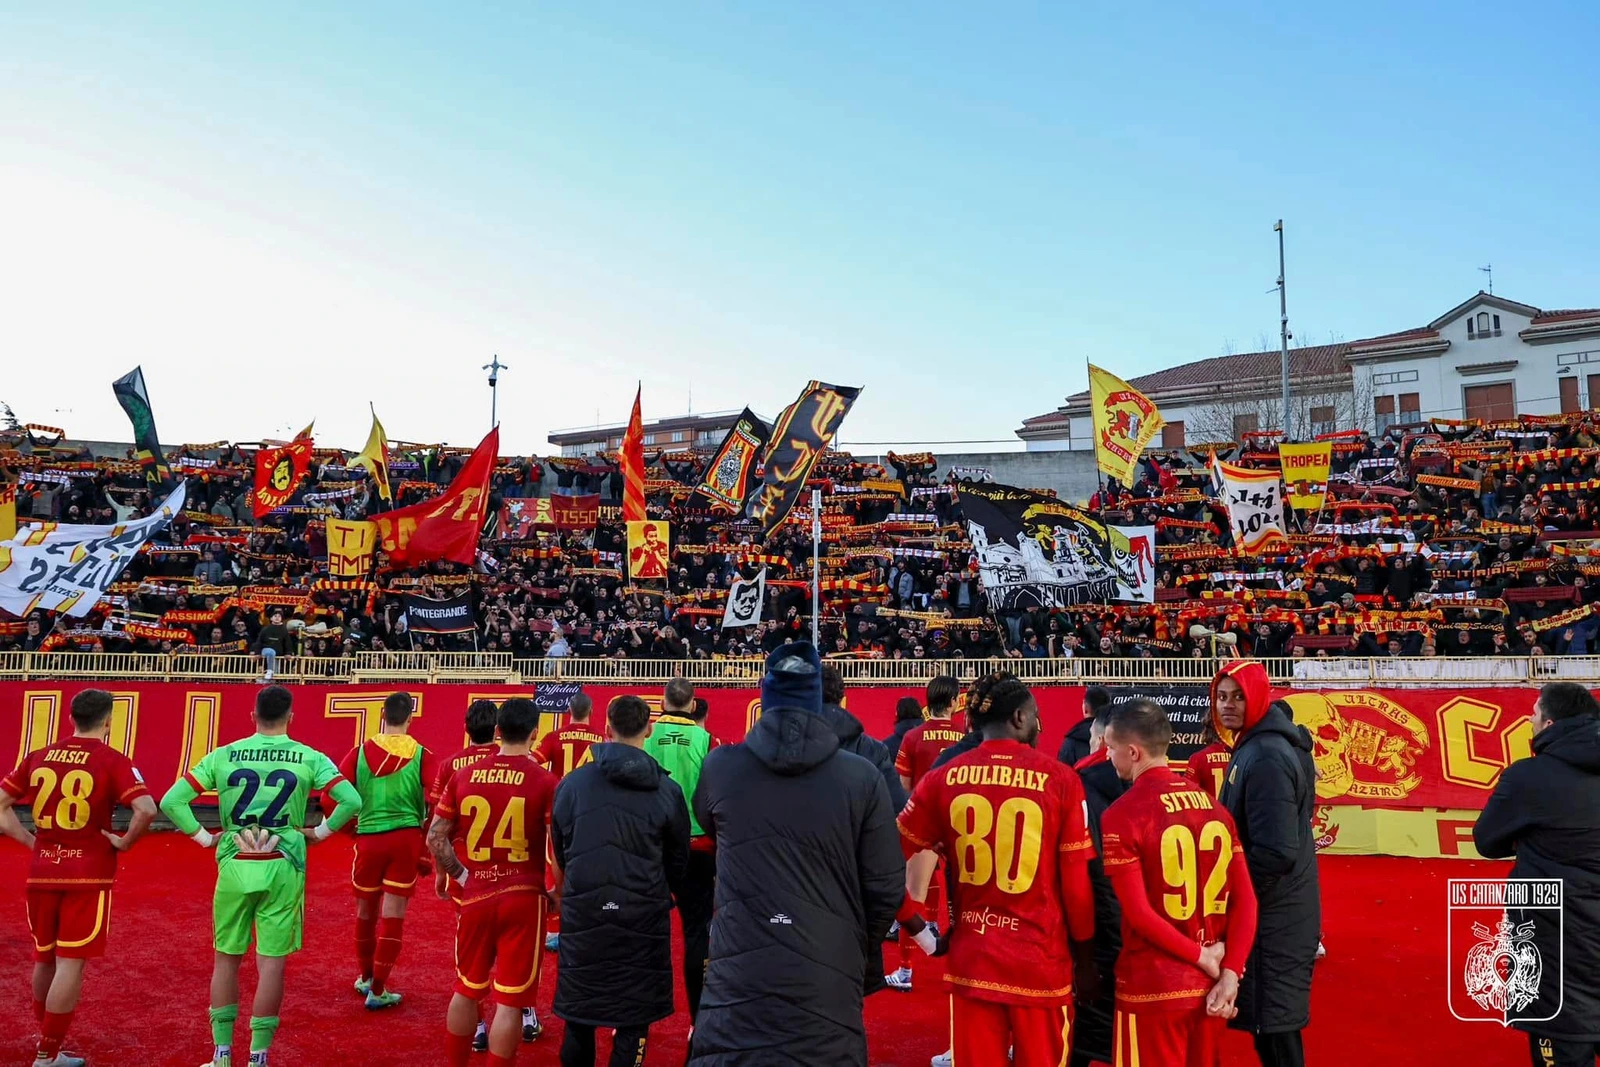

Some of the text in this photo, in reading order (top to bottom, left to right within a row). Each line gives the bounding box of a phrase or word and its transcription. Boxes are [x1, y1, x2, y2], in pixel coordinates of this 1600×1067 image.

[1283, 454, 1328, 469] TROPEA
[335, 525, 366, 548] TI
[329, 552, 373, 575] AMO
[409, 604, 468, 620] PONTEGRANDE
[124, 623, 187, 640] MASSIMO
[536, 682, 581, 695] Diffidati
[535, 695, 555, 707] Con
[1178, 694, 1189, 706] di
[1343, 694, 1410, 725] ULTRAS
[1182, 711, 1201, 723] voi.
[559, 730, 603, 743] SCOGNAMILLO
[44, 749, 91, 765] BIASCI
[229, 749, 304, 765] PIGLIACELLI
[469, 768, 526, 786] PAGANO
[945, 764, 1050, 792] COULIBALY
[29, 766, 94, 831] 28
[227, 768, 298, 828] 22
[1159, 790, 1214, 814] SITUM
[460, 794, 530, 863] 24
[950, 793, 1044, 895] 80
[1160, 820, 1234, 921] 92
[961, 909, 1020, 932] PRINCIPE
